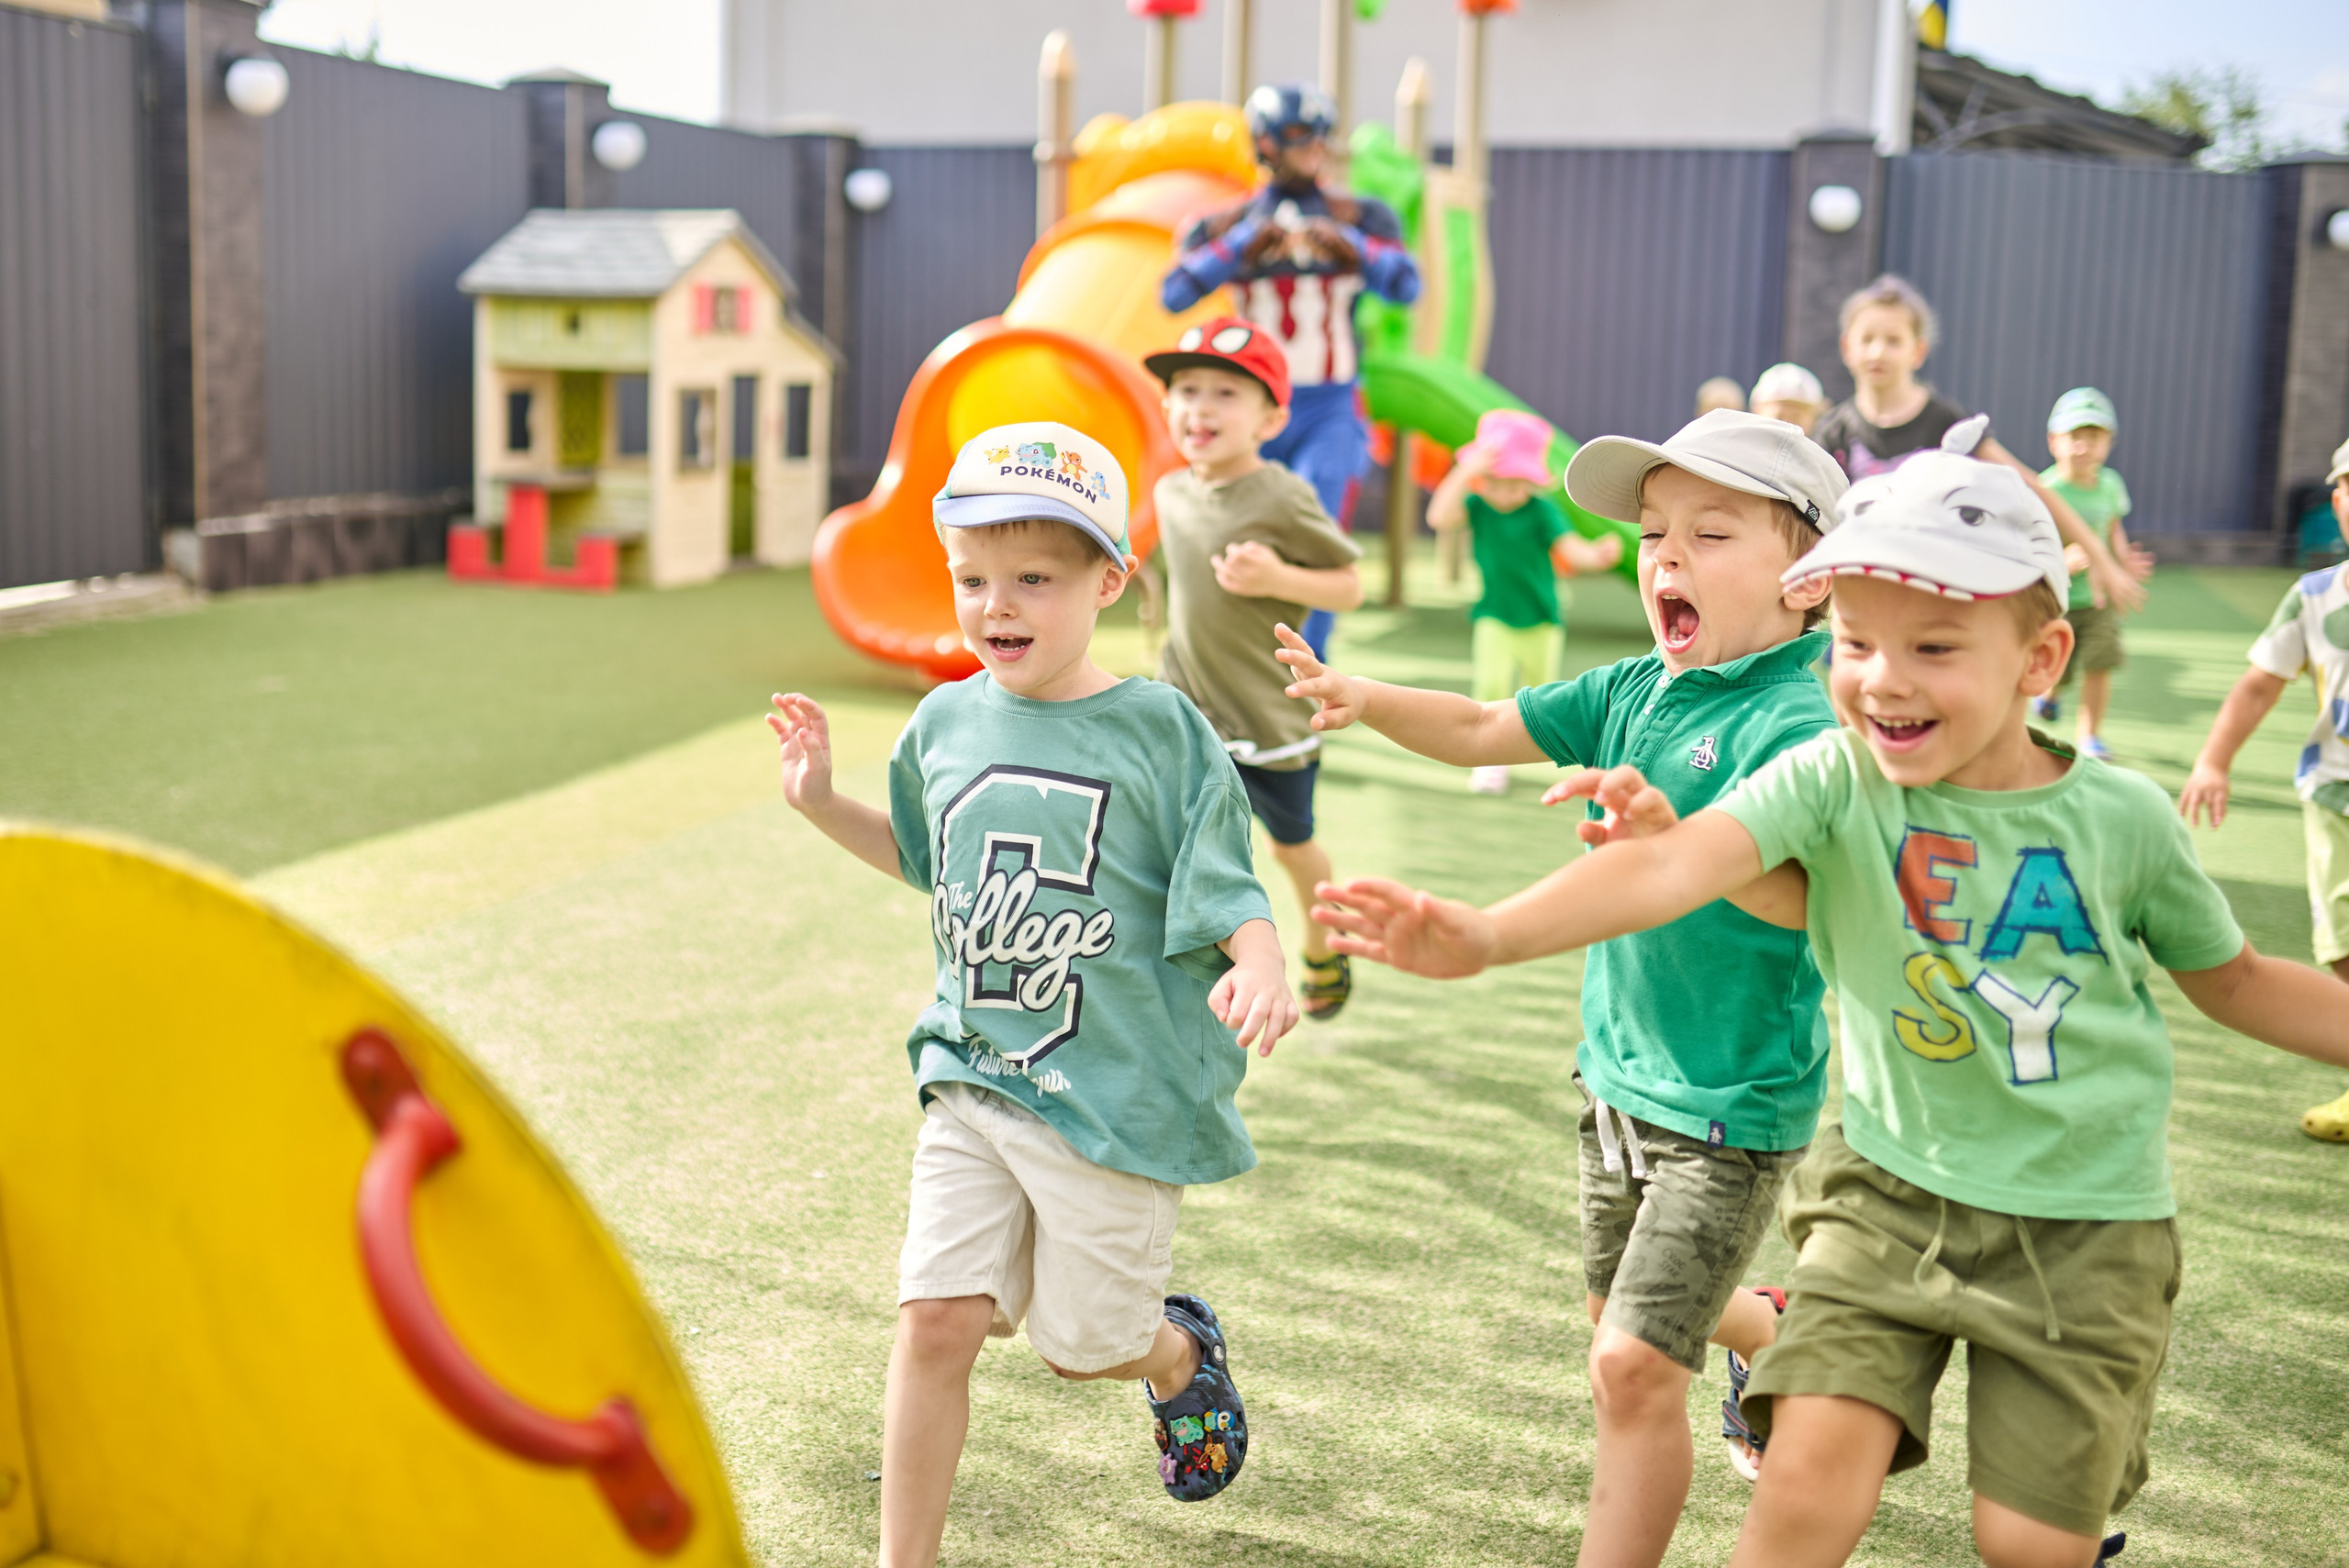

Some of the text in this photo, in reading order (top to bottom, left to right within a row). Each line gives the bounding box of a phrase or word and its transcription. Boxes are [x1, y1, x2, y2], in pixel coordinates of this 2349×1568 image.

[999, 465, 1097, 505] POKÉMON
[948, 880, 974, 910] The
[932, 867, 1115, 1013] College
[1658, 1260, 1681, 1280] STAR
[1662, 1248, 1687, 1271] CROC
